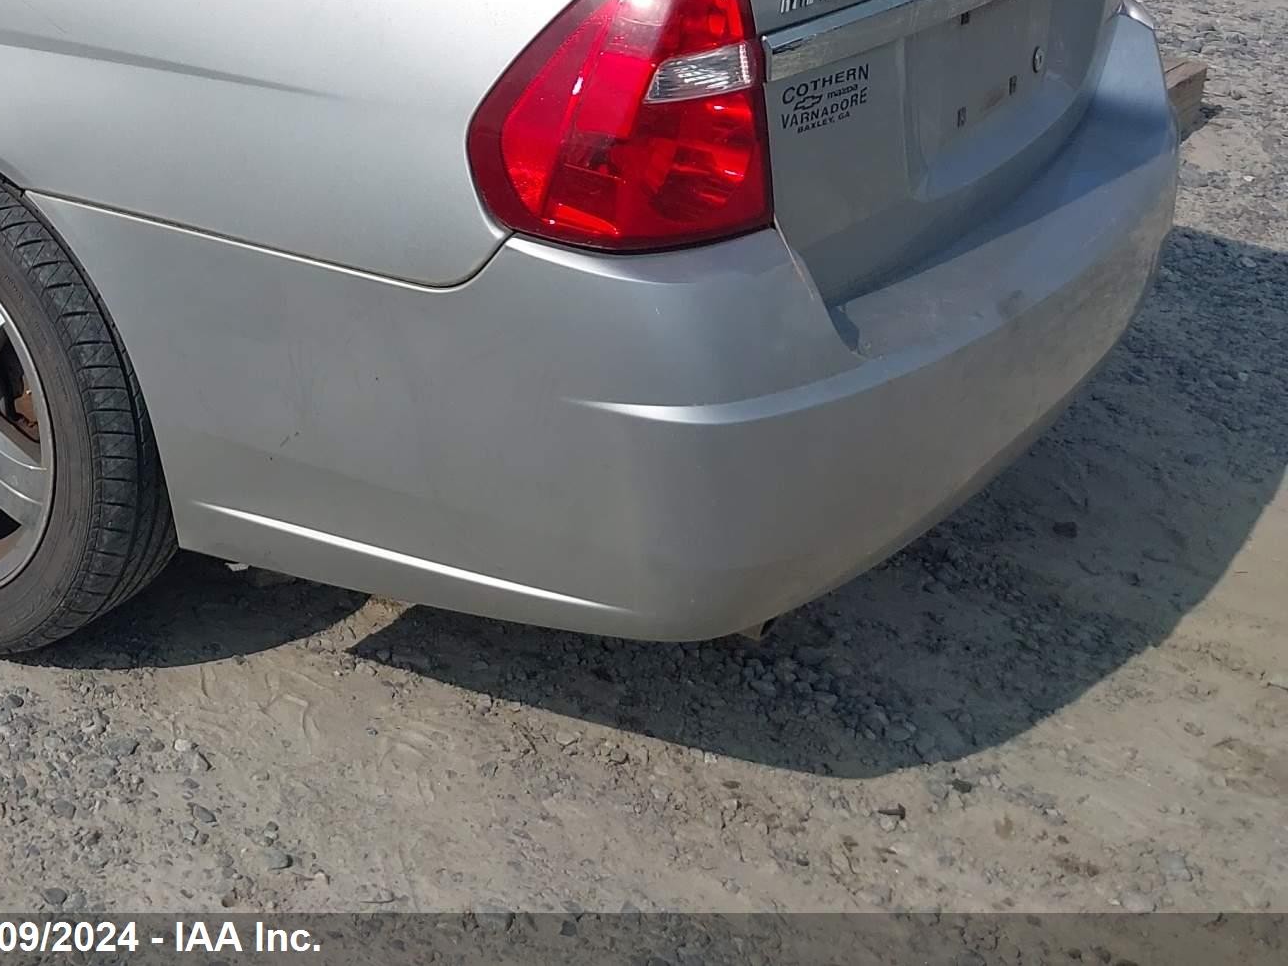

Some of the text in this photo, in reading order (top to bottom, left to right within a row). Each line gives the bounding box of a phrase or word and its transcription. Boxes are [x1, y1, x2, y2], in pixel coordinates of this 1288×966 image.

[782, 63, 869, 105] COTHERN
[827, 83, 858, 99] mazda
[781, 86, 868, 130] VARNADORE
[797, 111, 850, 134] BAXLEY, GA
